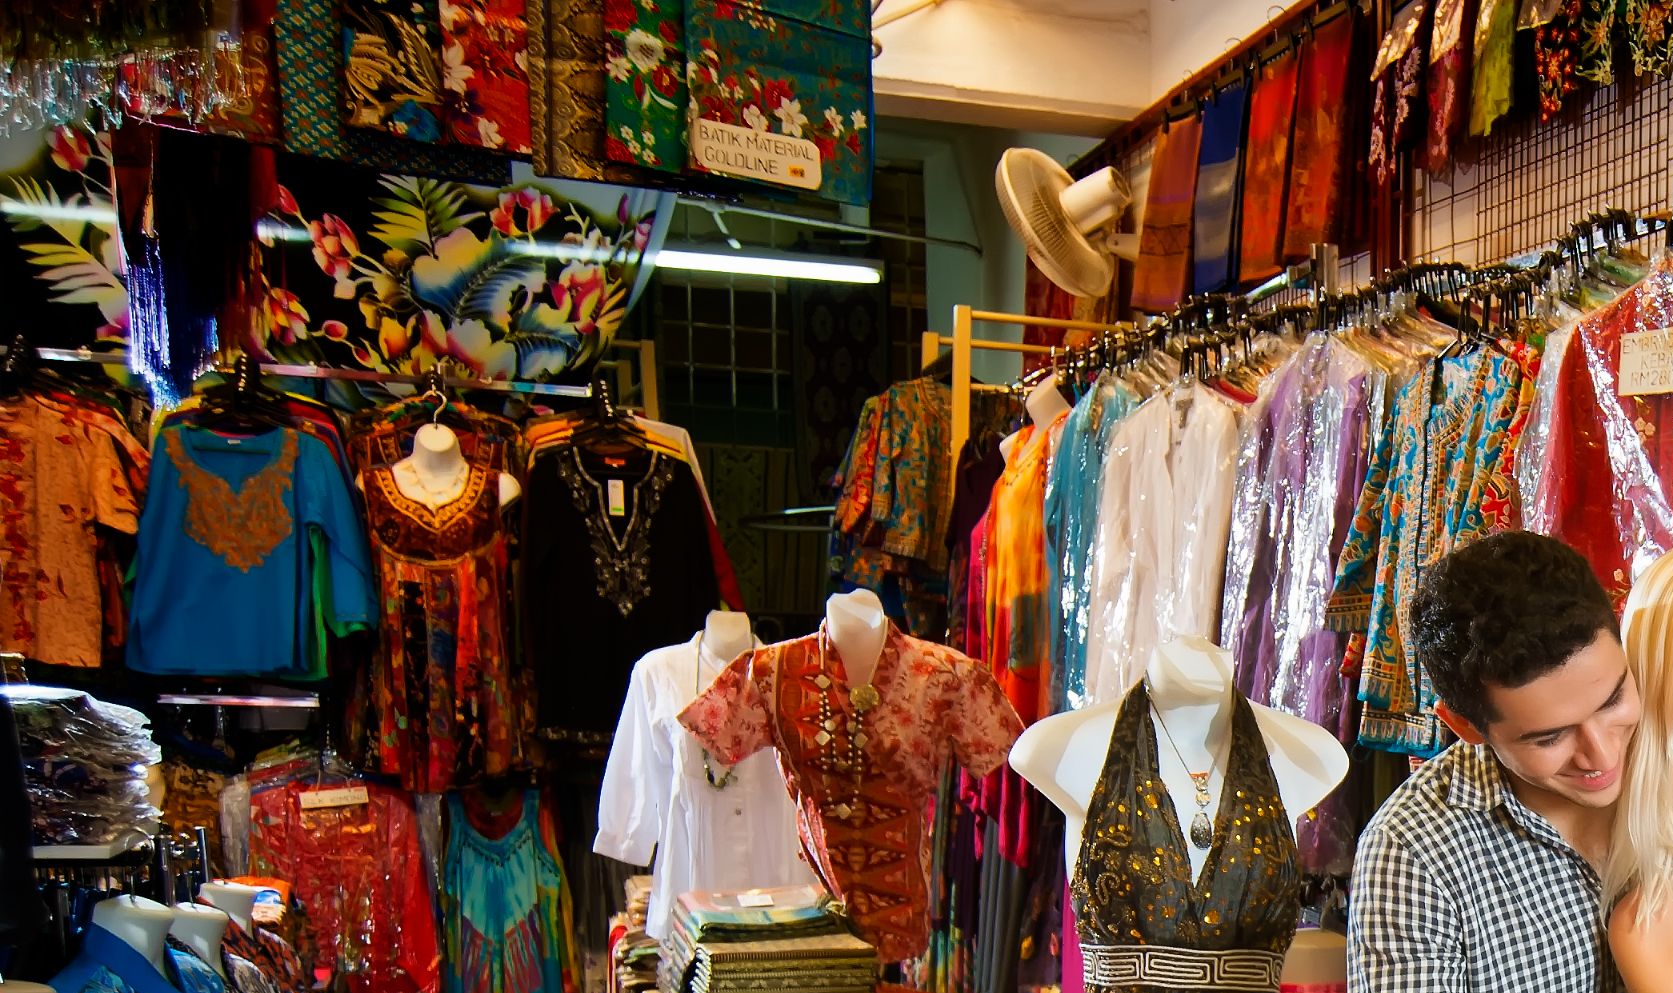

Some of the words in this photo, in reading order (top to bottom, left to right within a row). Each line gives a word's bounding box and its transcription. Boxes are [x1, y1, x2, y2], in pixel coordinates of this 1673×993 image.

[700, 125, 741, 146] BATIK
[746, 136, 813, 160] MATERIAL
[704, 145, 779, 174] GOLDLINE
